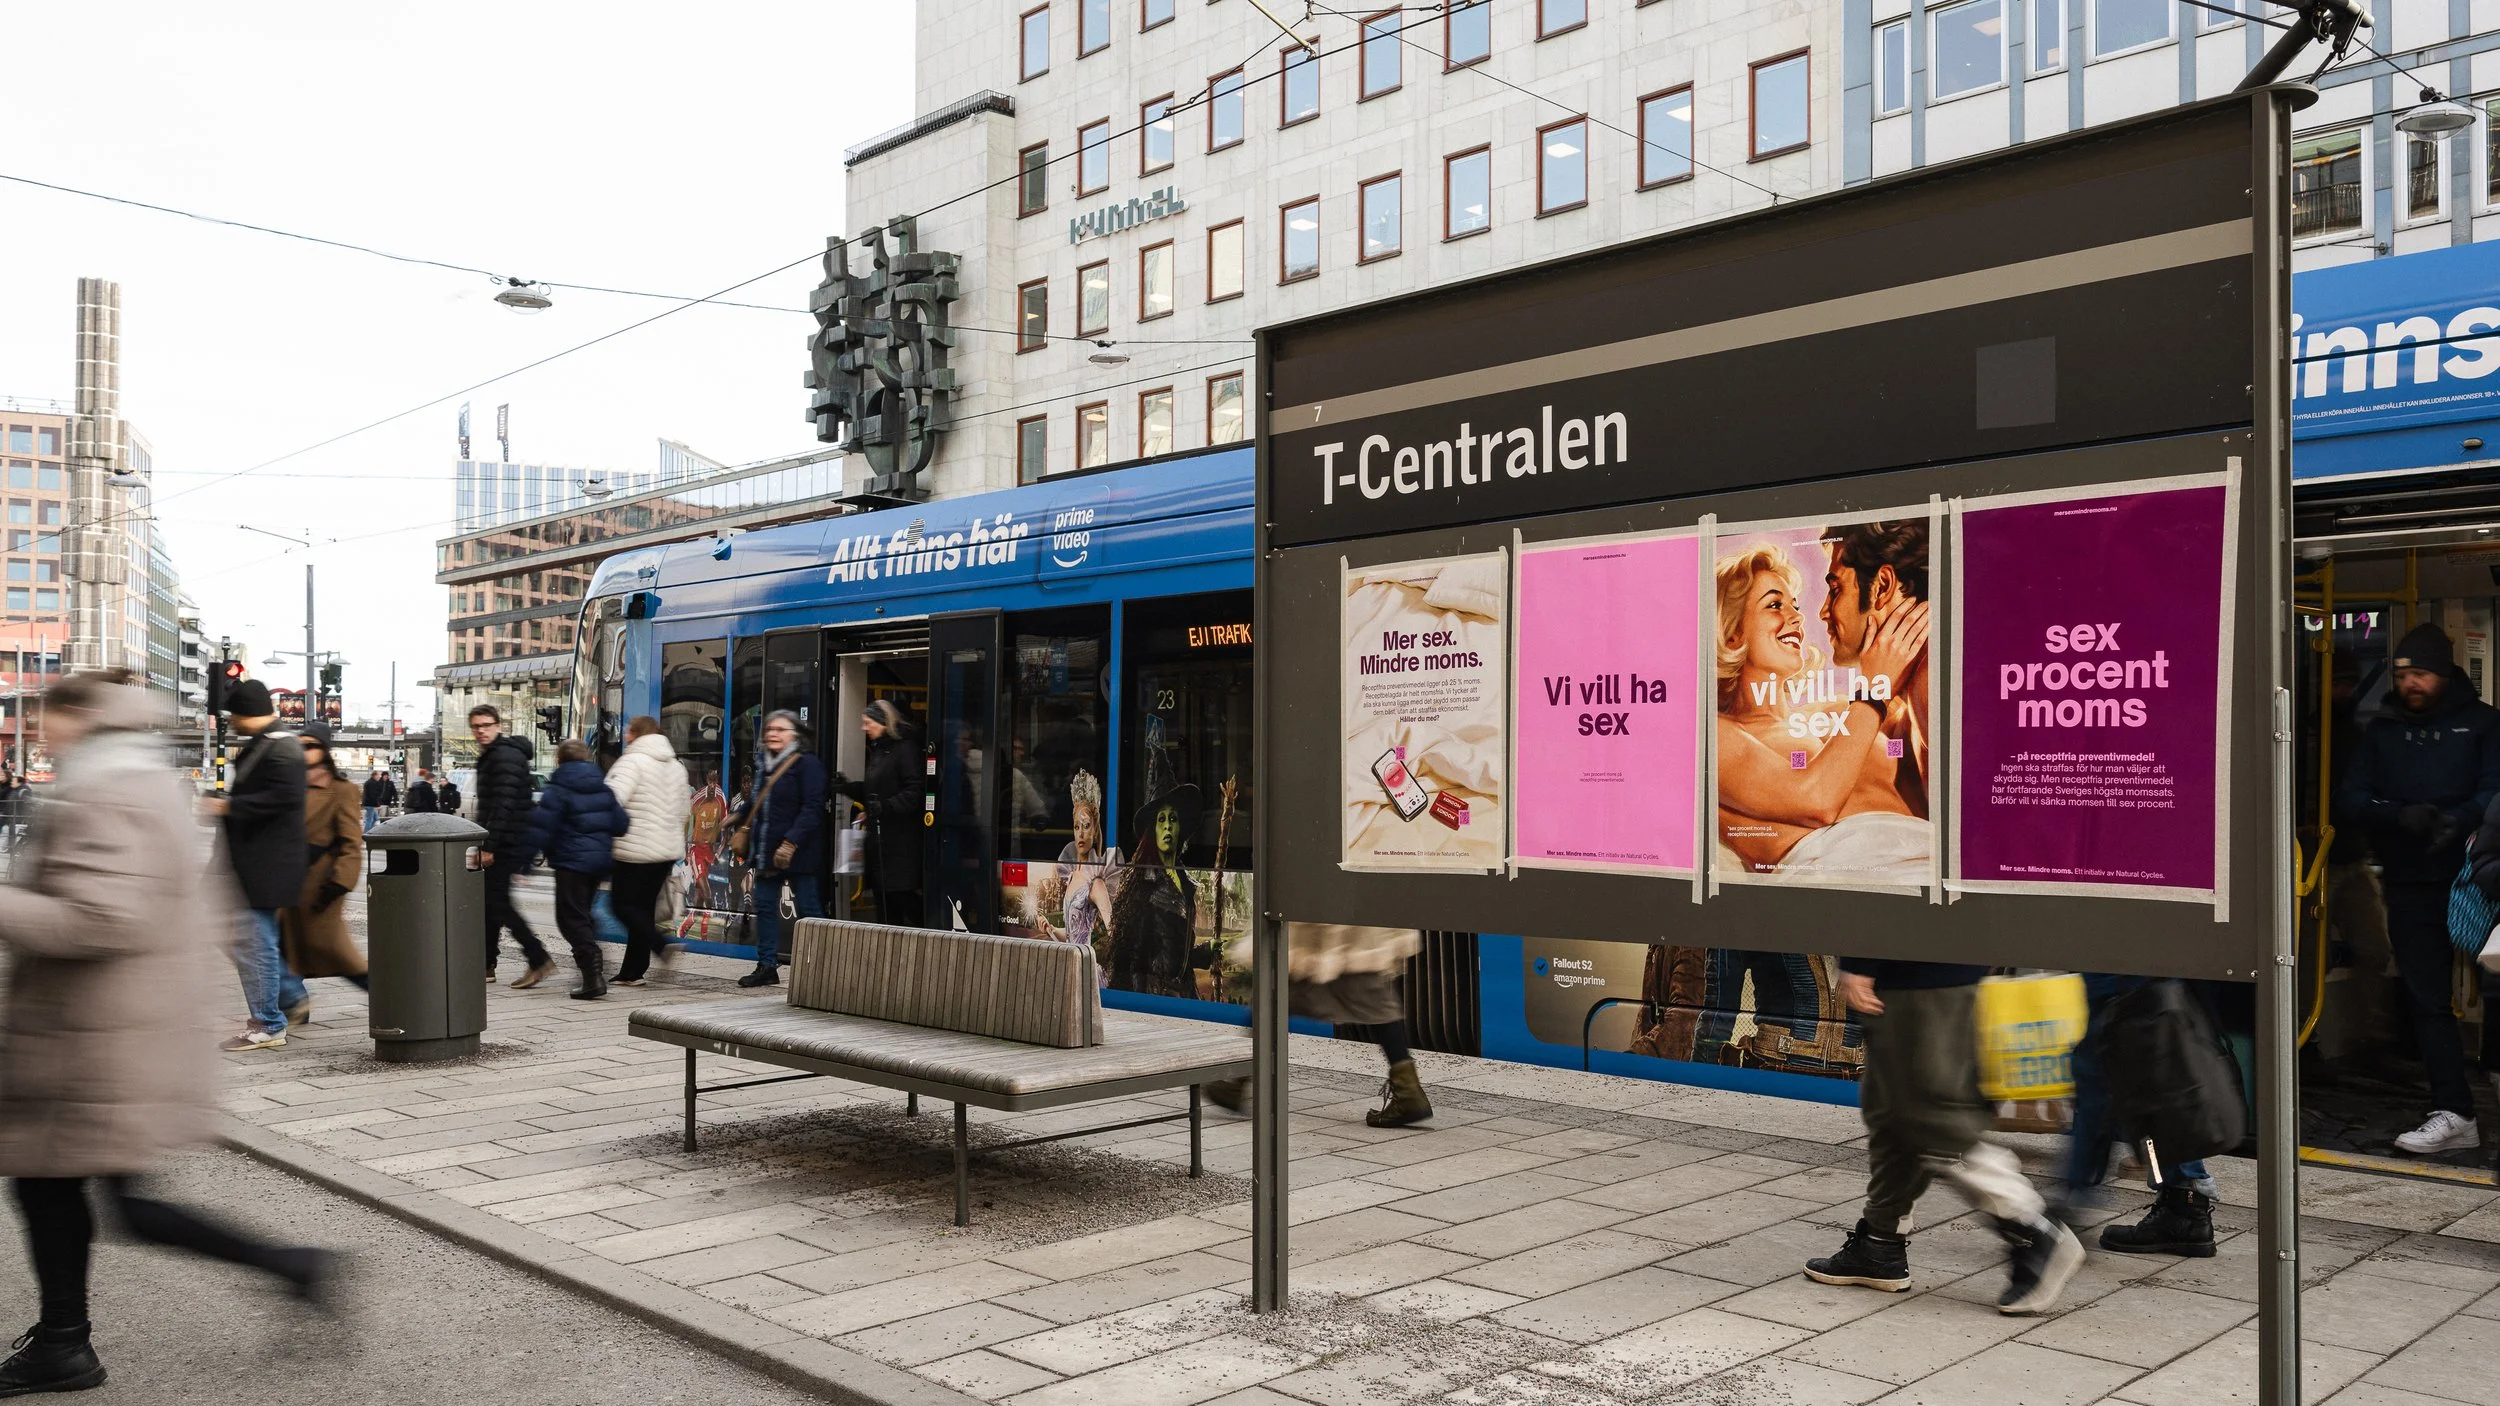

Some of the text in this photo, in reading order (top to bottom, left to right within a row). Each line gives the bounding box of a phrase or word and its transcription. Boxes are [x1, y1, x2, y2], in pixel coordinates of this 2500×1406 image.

[2419, 396, 2450, 406] INKLUDERA
[1314, 405, 1322, 423] 7
[1314, 405, 1628, 505] T-Centralen
[1054, 507, 1094, 532] prime
[827, 512, 1029, 584] Allt finns här
[1053, 531, 1090, 550] video
[1189, 627, 1202, 647] EJ
[1211, 623, 1253, 646] TRAFIK
[1383, 630, 1457, 651] Mer sex.
[2045, 623, 2121, 653] sex
[1360, 651, 1483, 675] Mindre moms.
[1441, 679, 1448, 688] på
[2001, 651, 2169, 699] procent
[1452, 688, 1469, 696] tycker
[1544, 673, 1667, 707] Vi vill ha
[1750, 668, 1892, 706] vi vill ha
[1157, 690, 1175, 709] 23
[2018, 698, 2147, 728] moms
[1577, 710, 1630, 737] sex
[1788, 710, 1851, 737] sex
[2018, 752, 2028, 762] på
[2031, 752, 2076, 762] receptfria
[2079, 752, 2154, 762] preventivmedel!
[2001, 764, 2023, 774] Ingen
[2025, 764, 2039, 772] ska
[2042, 764, 2074, 772] straffas
[2076, 764, 2088, 772] för
[2090, 764, 2103, 772] hur
[2127, 764, 2150, 775] väljer
[2153, 765, 2165, 773] att
[1994, 775, 2174, 785] skydda sig. Men receptfria preventivmedel
[1992, 785, 2175, 797] har fortfarande Sveriges högsta momssats.
[1992, 796, 2016, 804] Därför
[2018, 796, 2029, 804] vill
[2031, 796, 2039, 805] vi
[2040, 797, 2066, 806] sänka
[2106, 798, 2117, 807] till
[2119, 800, 2135, 808] sex
[2137, 800, 2175, 809] procent.
[2000, 864, 2012, 872] Mer
[2084, 868, 2105, 876] initiativ
[2116, 870, 2139, 878] Natural
[2141, 871, 2165, 880] Cycles.
[1007, 916, 1019, 924] Good
[1553, 958, 1592, 970] Fallout S2
[1554, 974, 1605, 986] amazon prime
